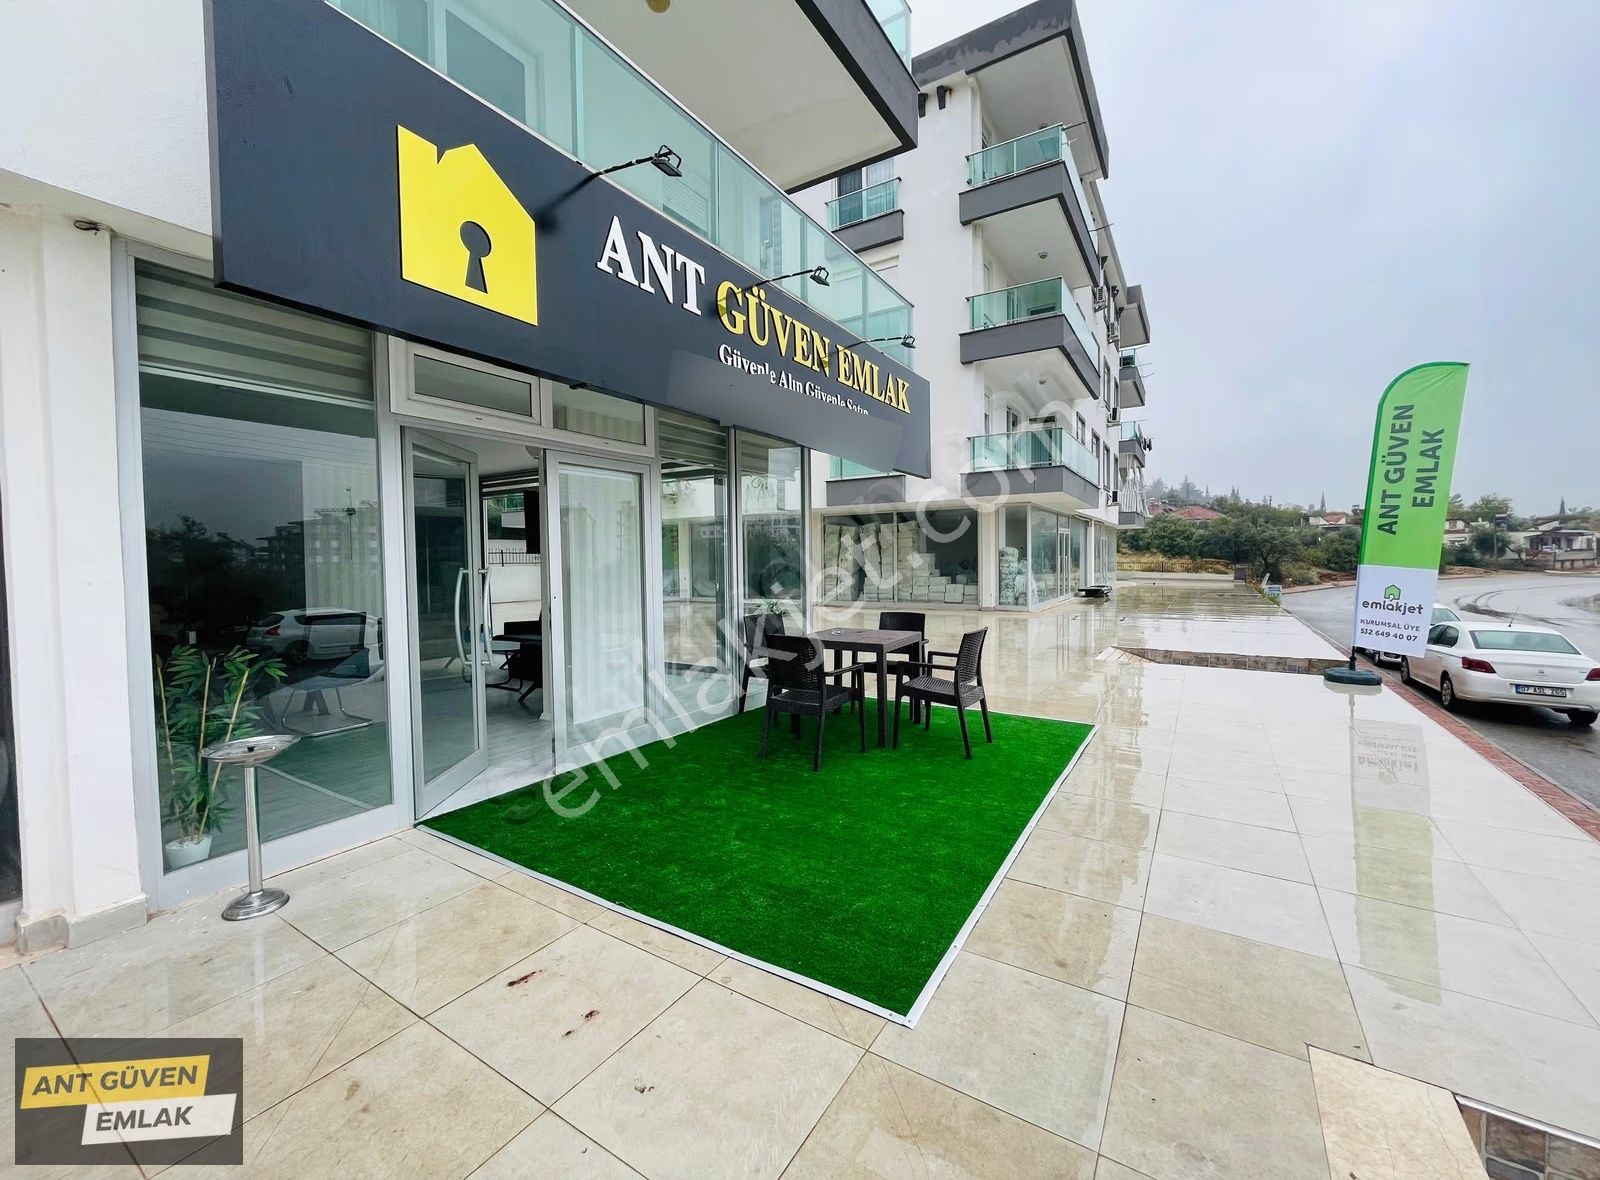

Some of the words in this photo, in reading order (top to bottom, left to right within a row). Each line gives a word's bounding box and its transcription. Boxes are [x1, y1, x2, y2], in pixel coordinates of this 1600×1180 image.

[597, 216, 705, 316] ANT
[716, 280, 830, 378] GÜVEN
[836, 344, 911, 414] EMLAK
[1381, 404, 1415, 484] GÜVEN
[1411, 428, 1445, 508] EMLAK
[1377, 489, 1402, 535] ANT
[1360, 618, 1402, 630] KURUMSAL
[1403, 623, 1420, 632] ÜYE
[1362, 600, 1424, 615] emlakjet
[1360, 627, 1373, 636] 532
[1375, 630, 1391, 638] 649
[1392, 632, 1404, 640] 40
[1406, 634, 1418, 642] 07
